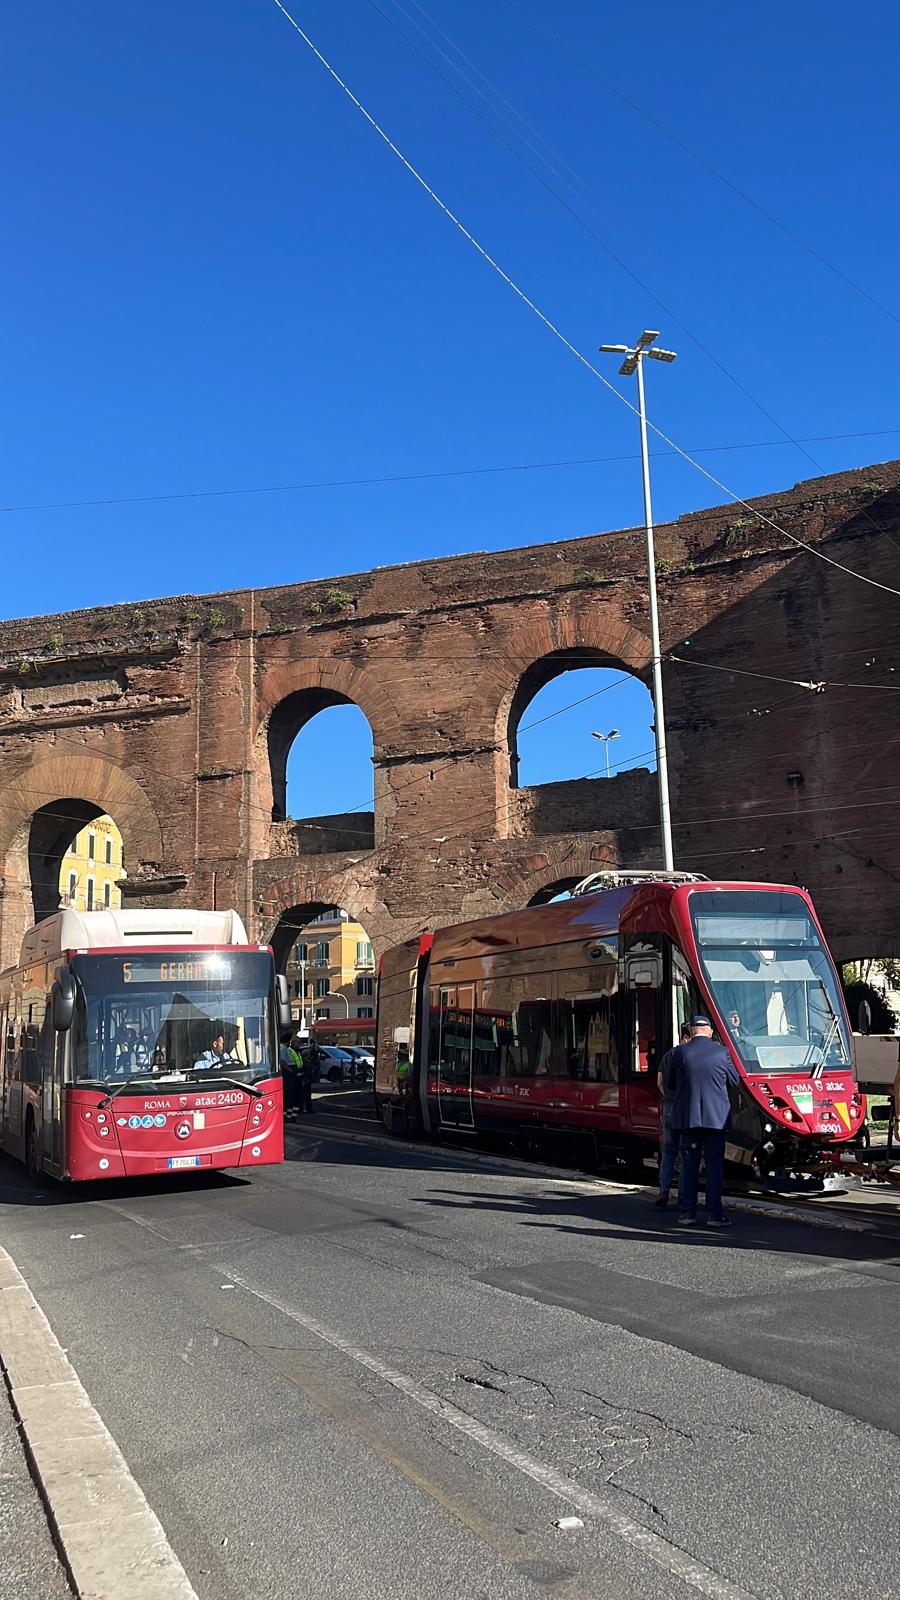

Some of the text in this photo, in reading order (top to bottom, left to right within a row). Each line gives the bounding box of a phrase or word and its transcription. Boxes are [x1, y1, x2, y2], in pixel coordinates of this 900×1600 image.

[123, 962, 132, 983] 5
[786, 1082, 845, 1093] ROMA atac
[144, 1092, 244, 1109] ROMA atac 2409
